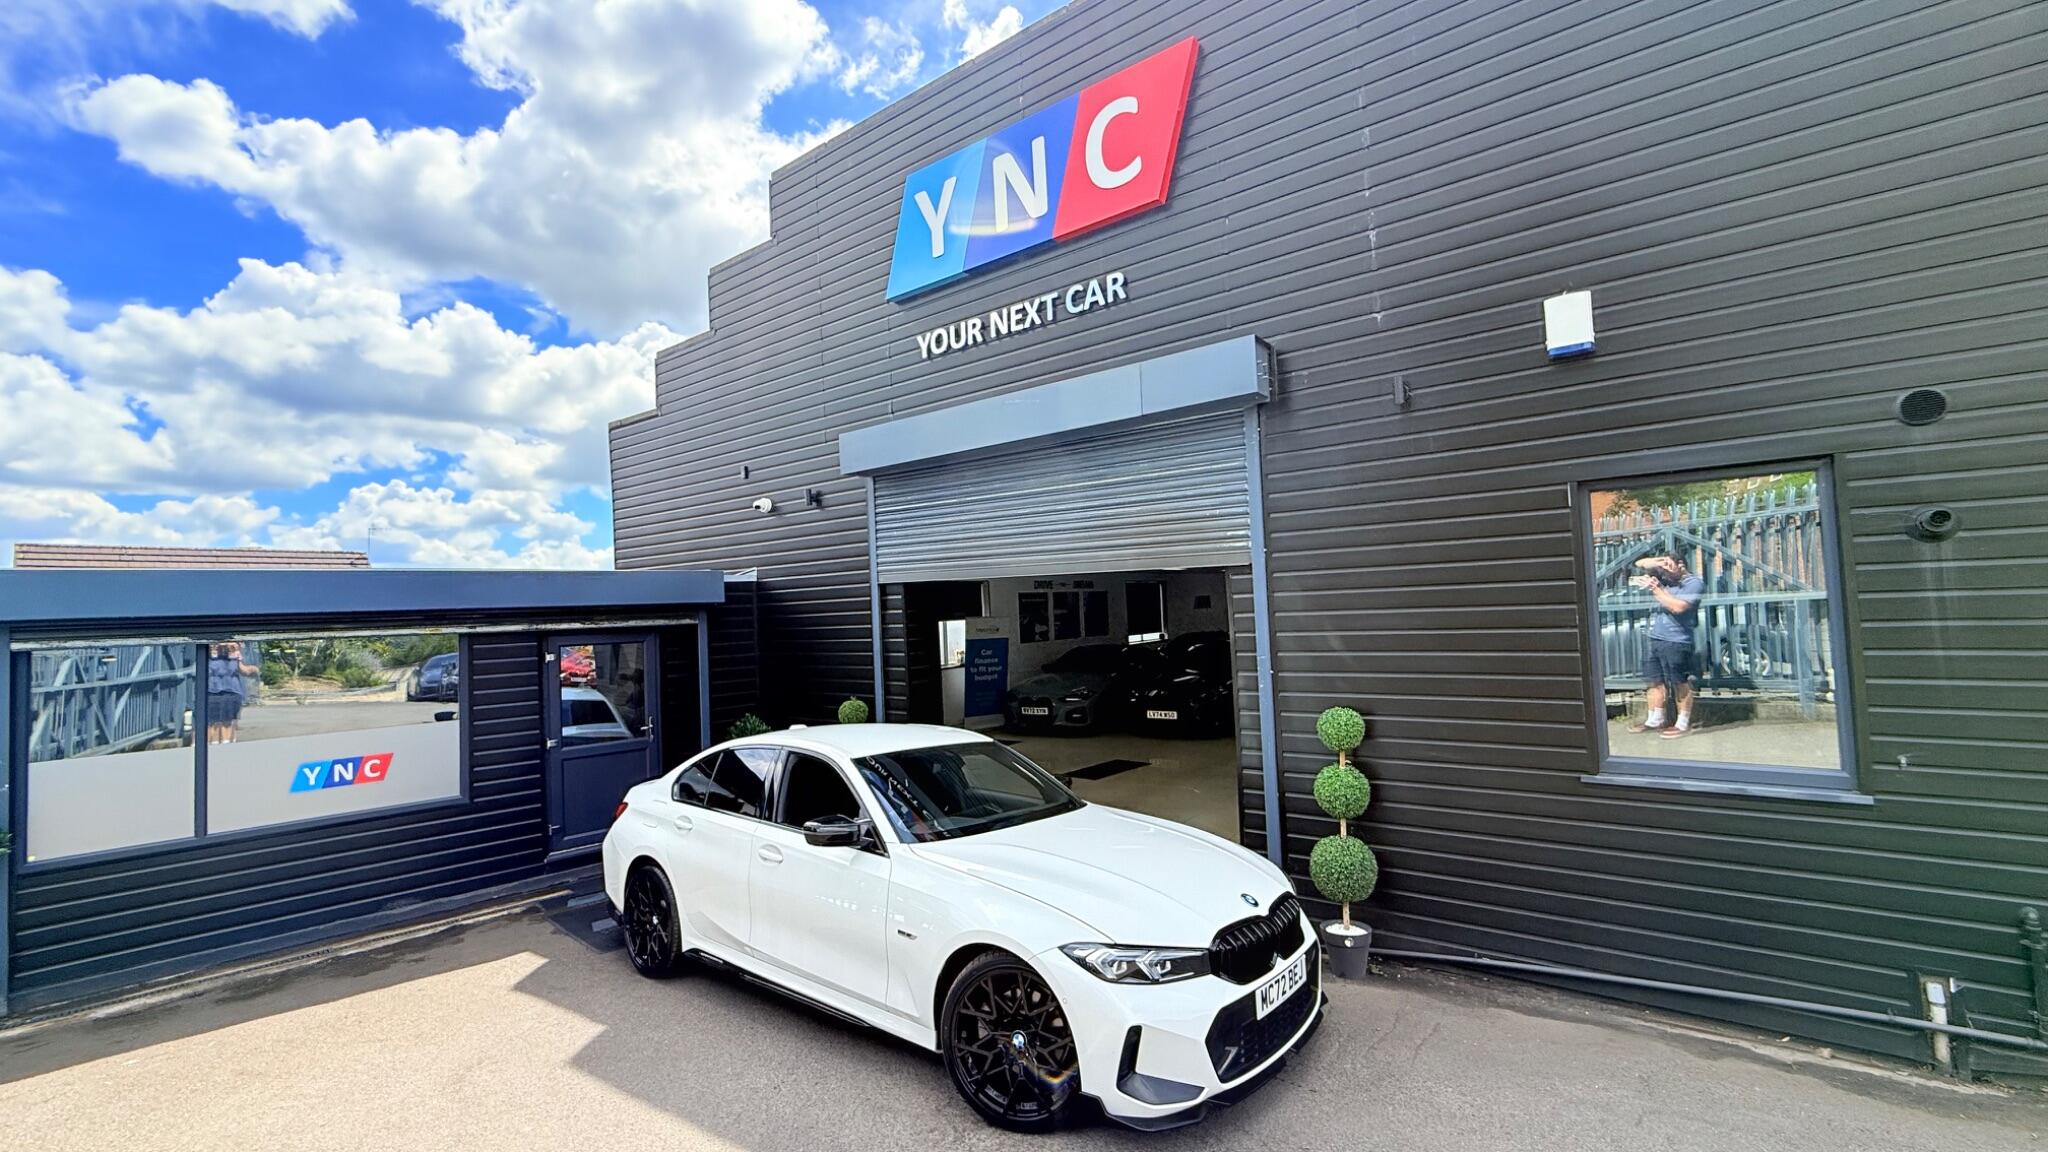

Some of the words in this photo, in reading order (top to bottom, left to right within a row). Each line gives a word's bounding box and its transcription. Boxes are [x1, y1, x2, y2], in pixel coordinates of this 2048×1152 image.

[914, 96, 1142, 258] YNC
[916, 317, 983, 359] YOUR
[990, 291, 1058, 338] NEXT
[1065, 271, 1126, 314] CAR
[974, 657, 999, 665] finance
[980, 648, 993, 656] Car
[302, 759, 381, 786] YNC
[1260, 974, 1287, 1011] MC72
[1288, 959, 1304, 990] BEJ
